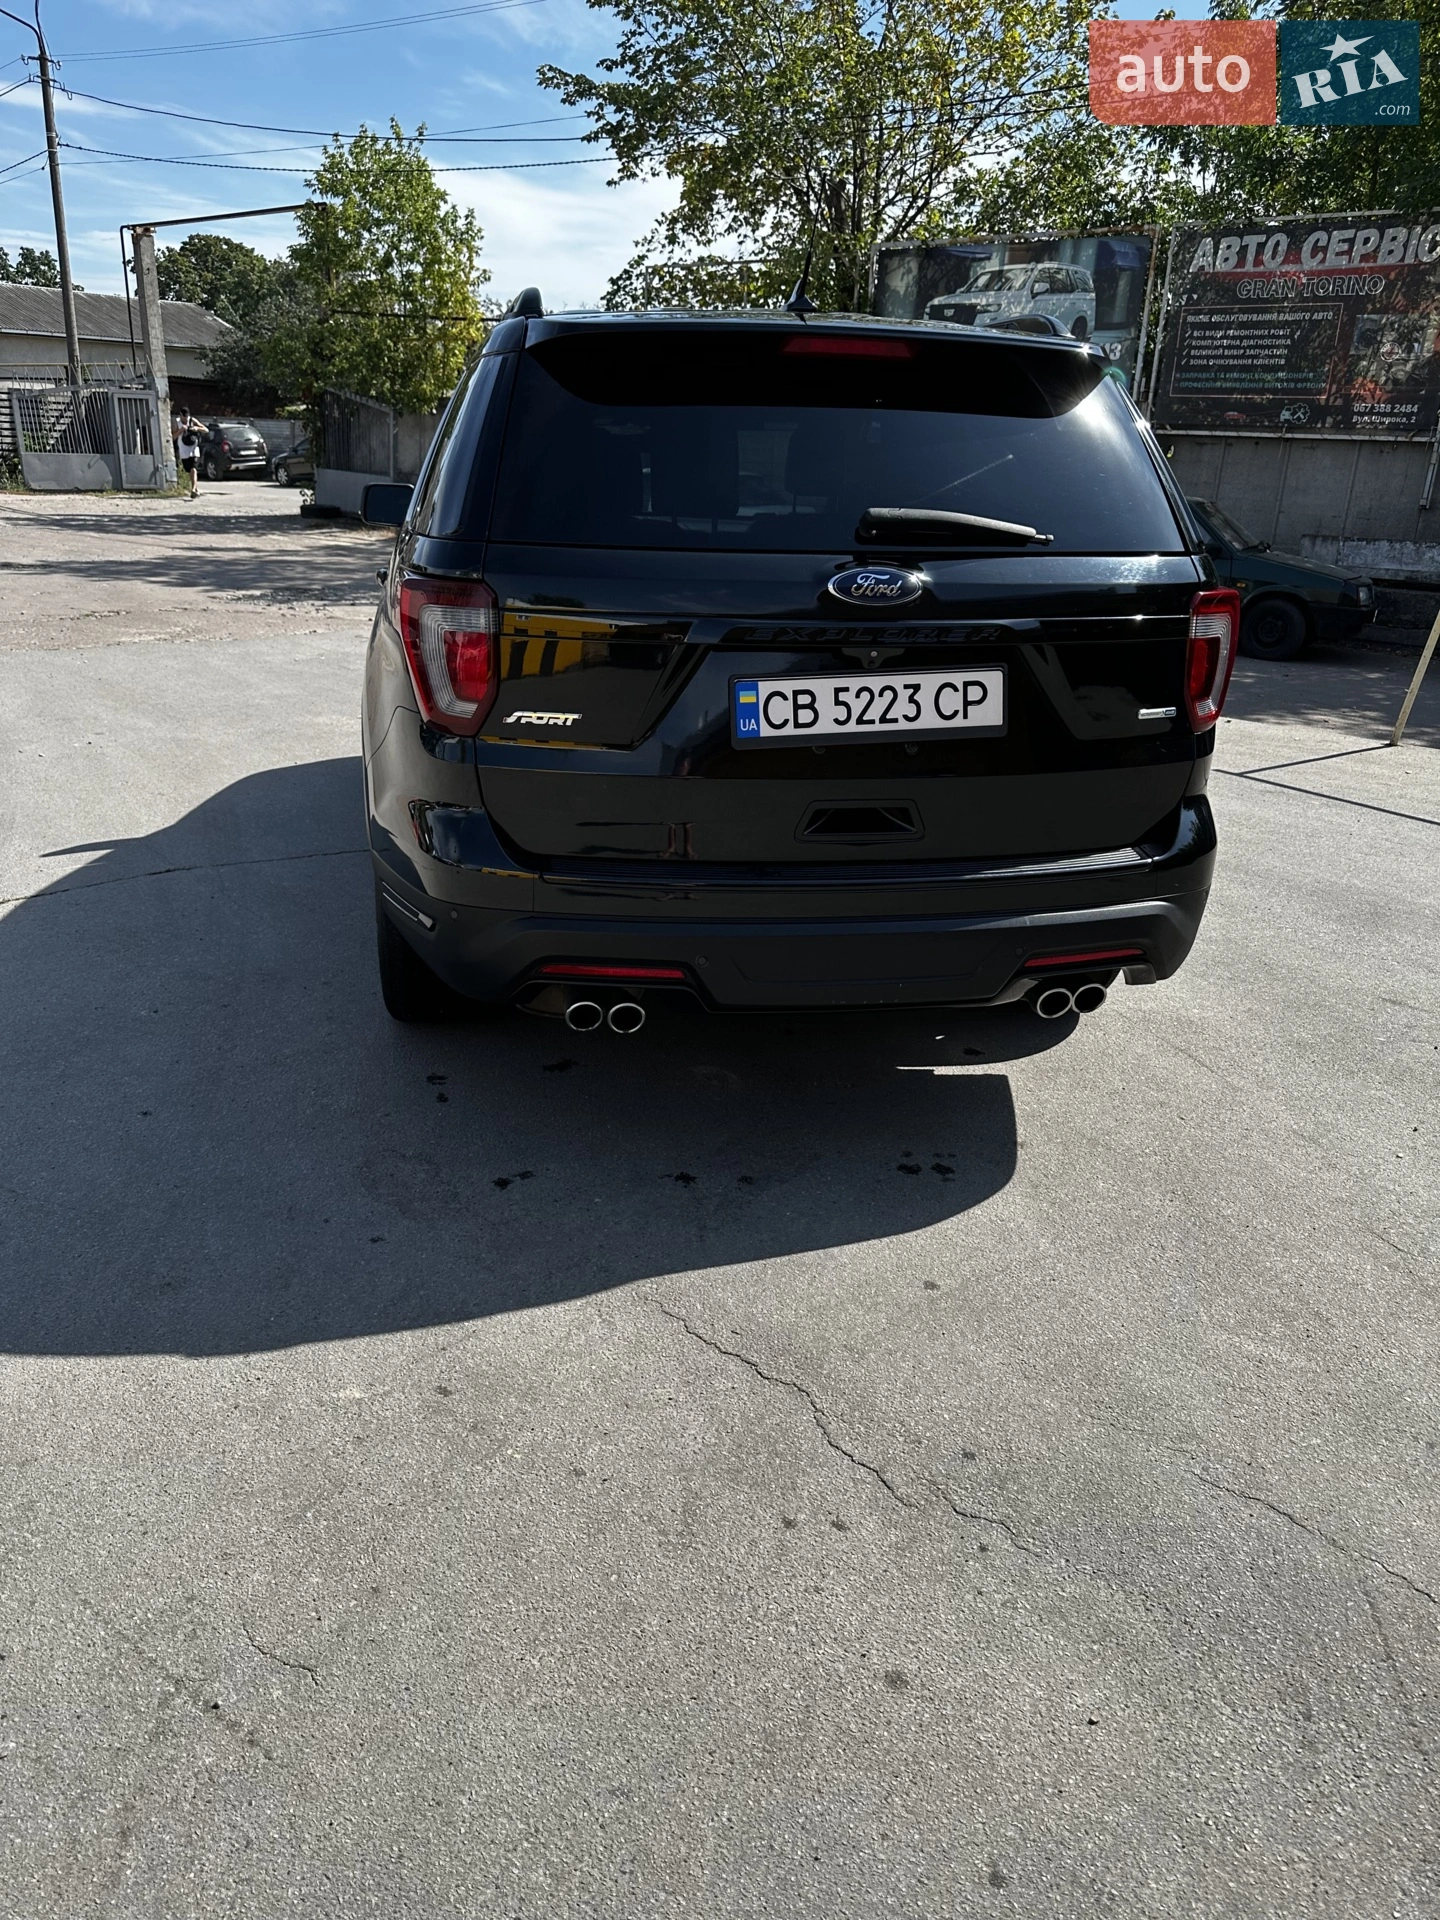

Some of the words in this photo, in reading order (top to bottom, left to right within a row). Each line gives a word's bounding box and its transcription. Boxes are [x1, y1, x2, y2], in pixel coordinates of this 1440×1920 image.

[1189, 232, 1290, 273] АВТО
[1300, 224, 1440, 270] СЕРВІС
[1236, 277, 1299, 299] GRAN
[1302, 274, 1386, 297] TORINO
[1279, 312, 1312, 321] ВАШОГО
[1312, 311, 1334, 320] АВТО
[1225, 329, 1269, 337] РЕМОНТНИХ
[1270, 328, 1291, 336] РОБІТ
[1241, 338, 1292, 347] ДІАГНОСТИКА
[1190, 348, 1223, 356] ВЕЛИКИЙ
[1244, 348, 1289, 356] ЗАПЧАСТИН
[1189, 358, 1208, 366] ЗОНА
[1208, 358, 1253, 366] ОЧІКУВАННЯ
[1353, 403, 1372, 413] 067
[1372, 403, 1392, 413] 388
[1392, 403, 1419, 413] 2484
[850, 573, 902, 598] Ford
[744, 627, 1001, 643] EXPLORER
[762, 689, 820, 731] CB
[832, 681, 923, 726] 5223
[932, 679, 989, 721] CP
[502, 710, 583, 726] SPORT
[740, 718, 758, 732] UA
